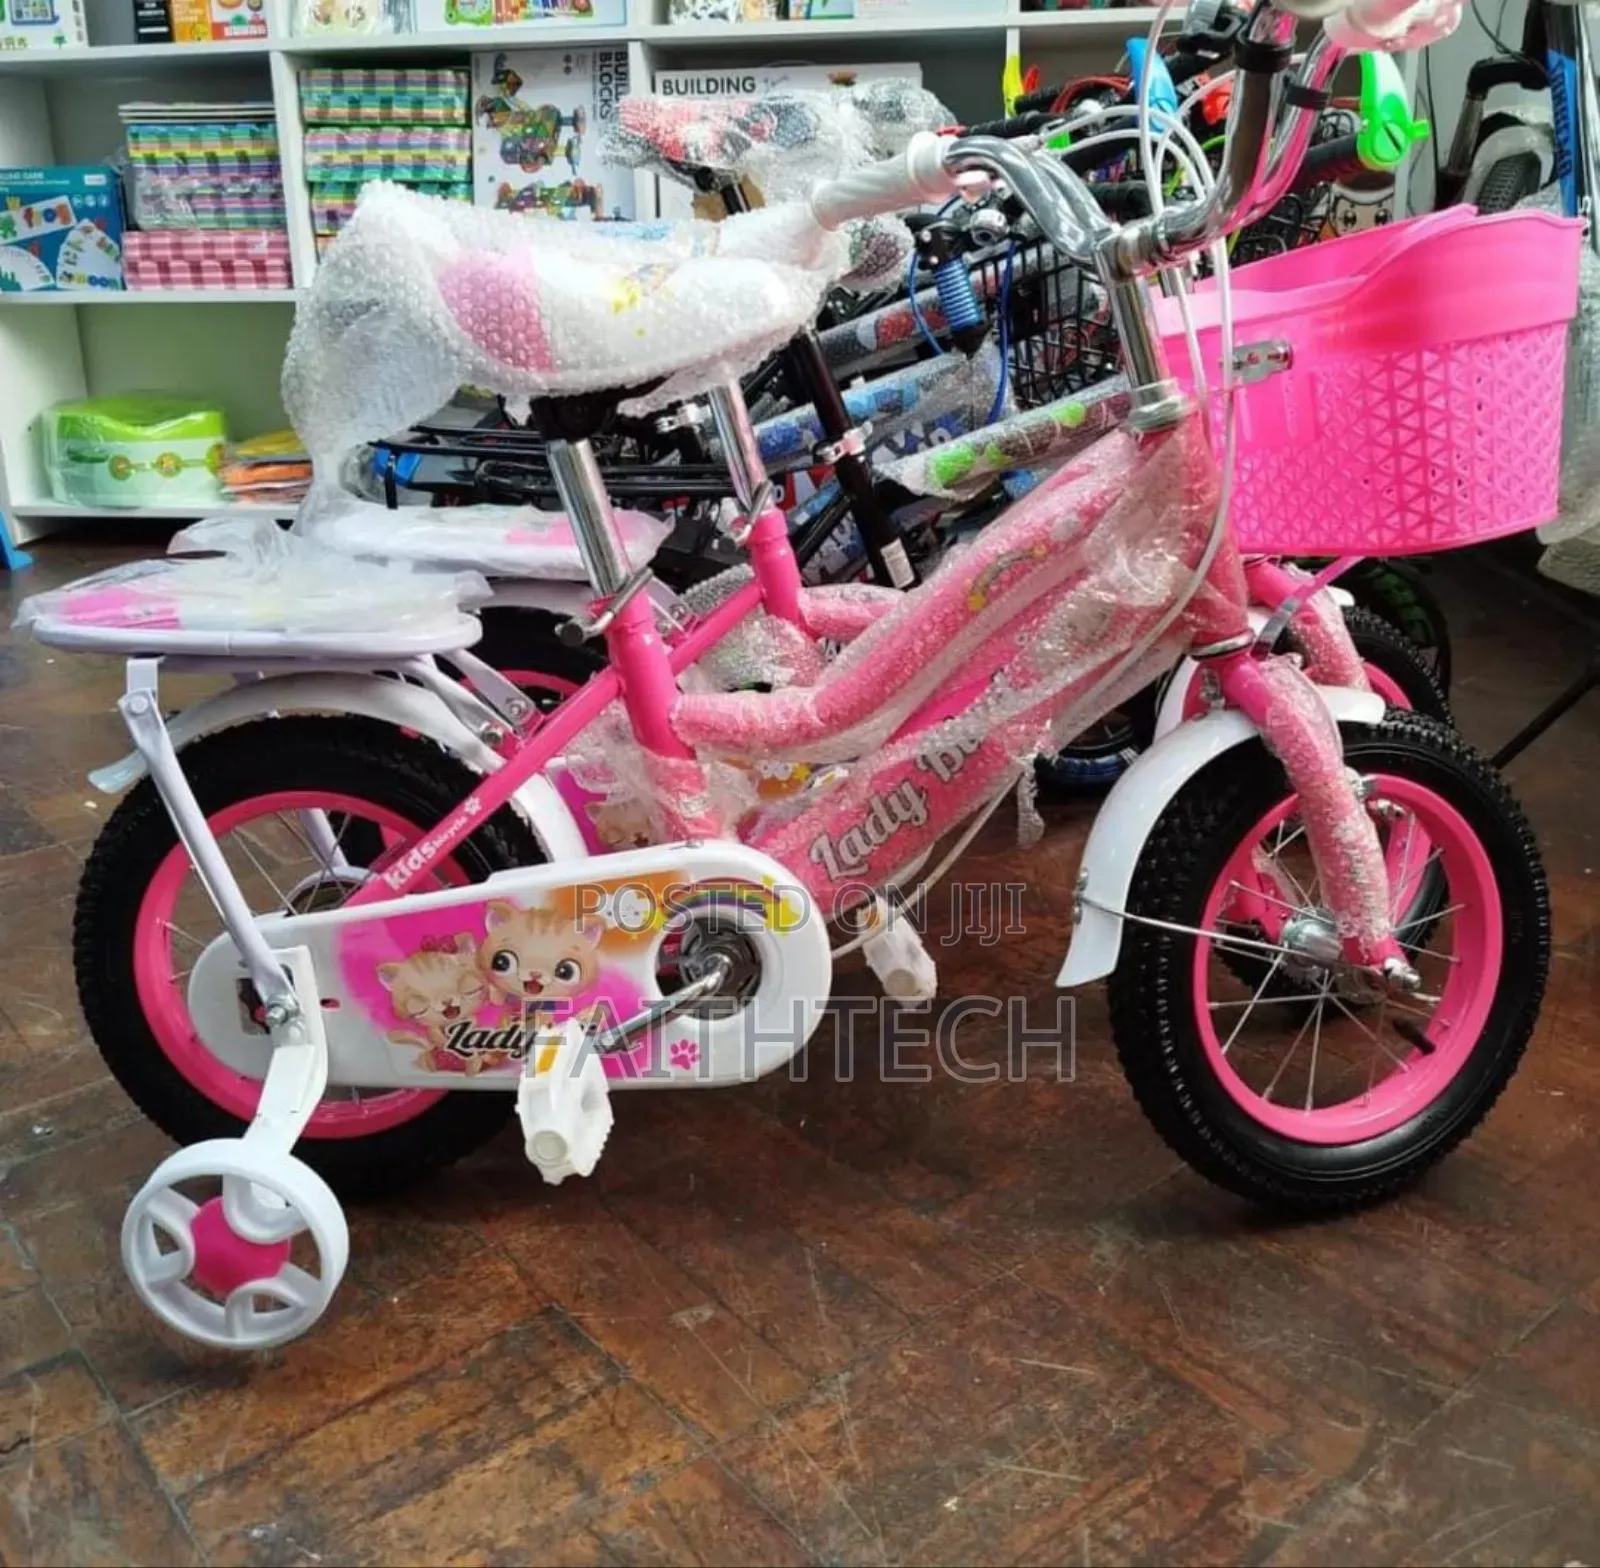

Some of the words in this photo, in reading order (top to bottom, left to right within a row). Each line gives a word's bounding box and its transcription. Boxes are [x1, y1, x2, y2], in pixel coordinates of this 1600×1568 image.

[599, 52, 613, 119] BLOCKS
[662, 76, 756, 96] BUILDING
[808, 778, 930, 882] Lady
[383, 842, 437, 892] kids
[446, 1019, 538, 1060] Lady
